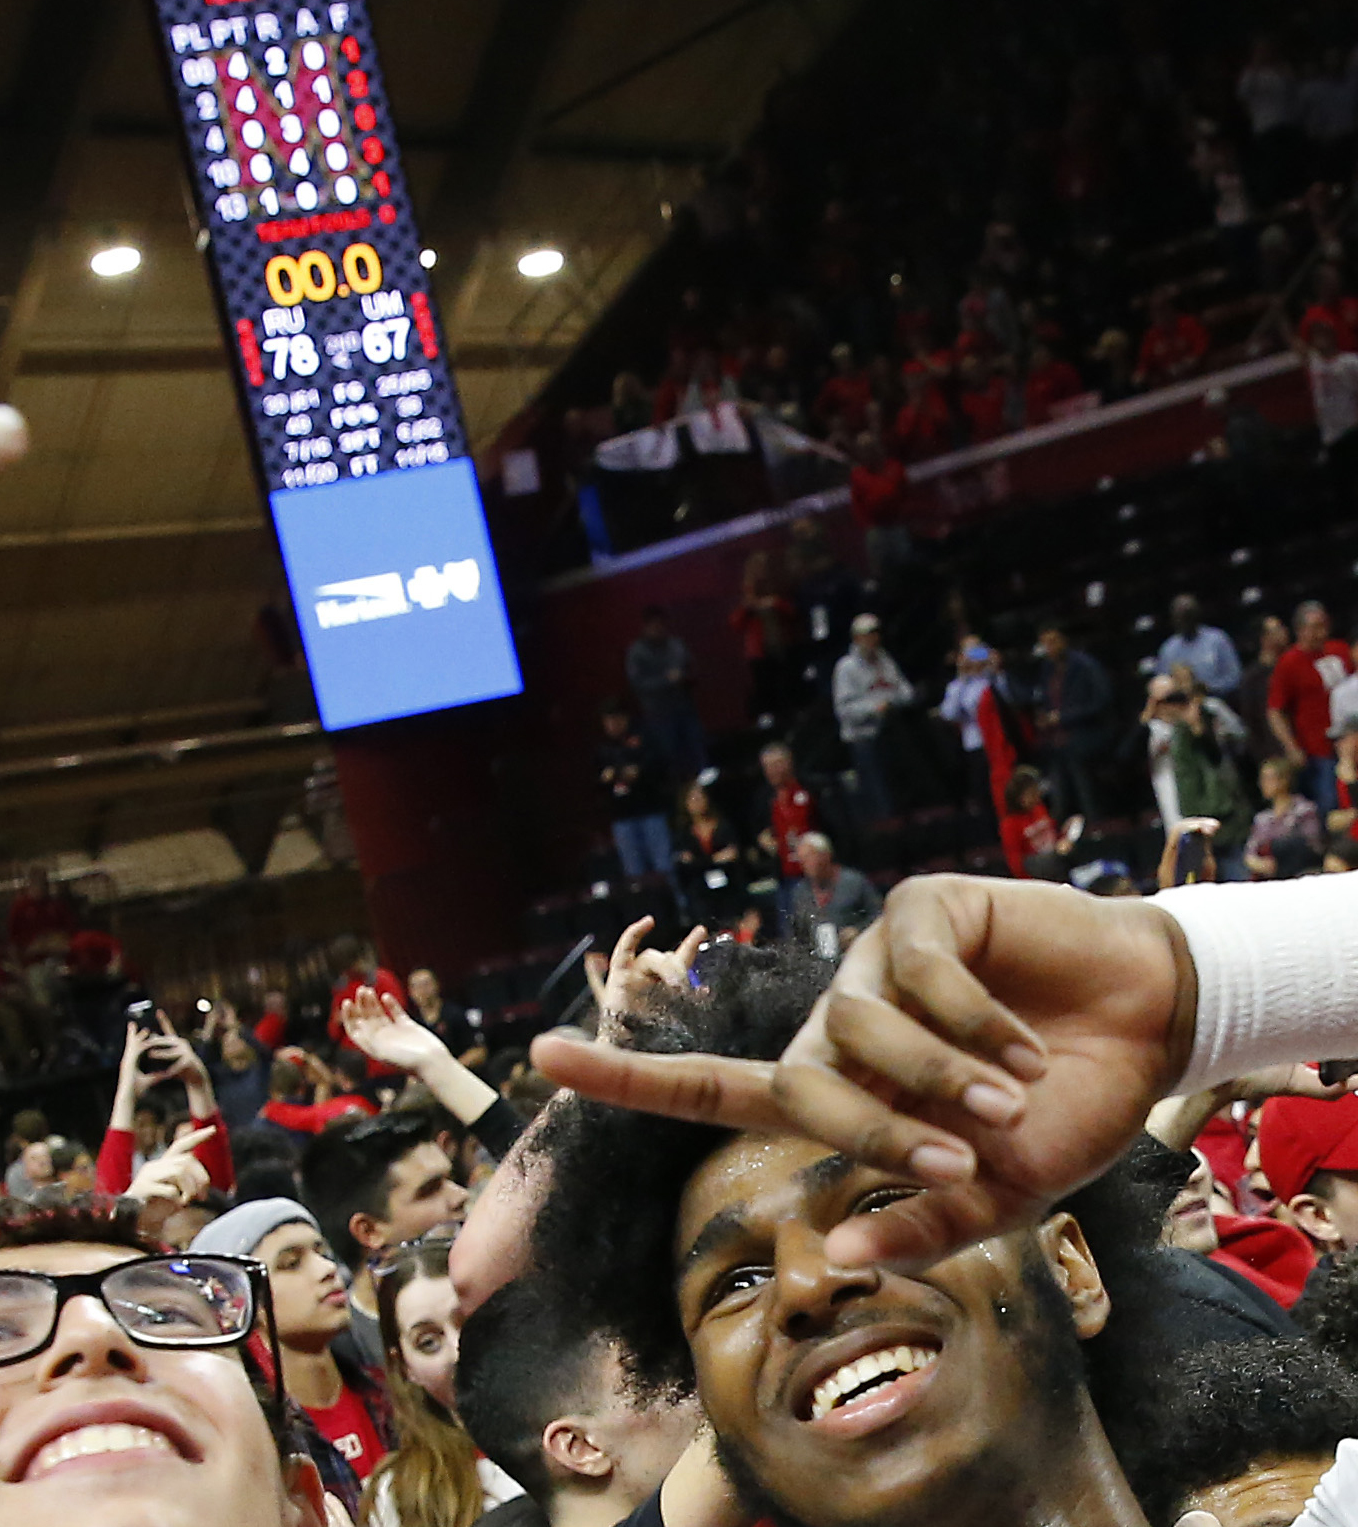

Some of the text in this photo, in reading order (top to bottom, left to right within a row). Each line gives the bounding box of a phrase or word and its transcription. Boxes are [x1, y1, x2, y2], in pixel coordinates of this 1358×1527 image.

[296, 8, 320, 37] A
[274, 80, 294, 110] 1
[311, 74, 332, 104] 1
[259, 186, 280, 216] 1
[265, 242, 383, 306] 00.0
[262, 289, 405, 338] RU UM
[262, 333, 321, 380] 78
[361, 316, 411, 364] 67
